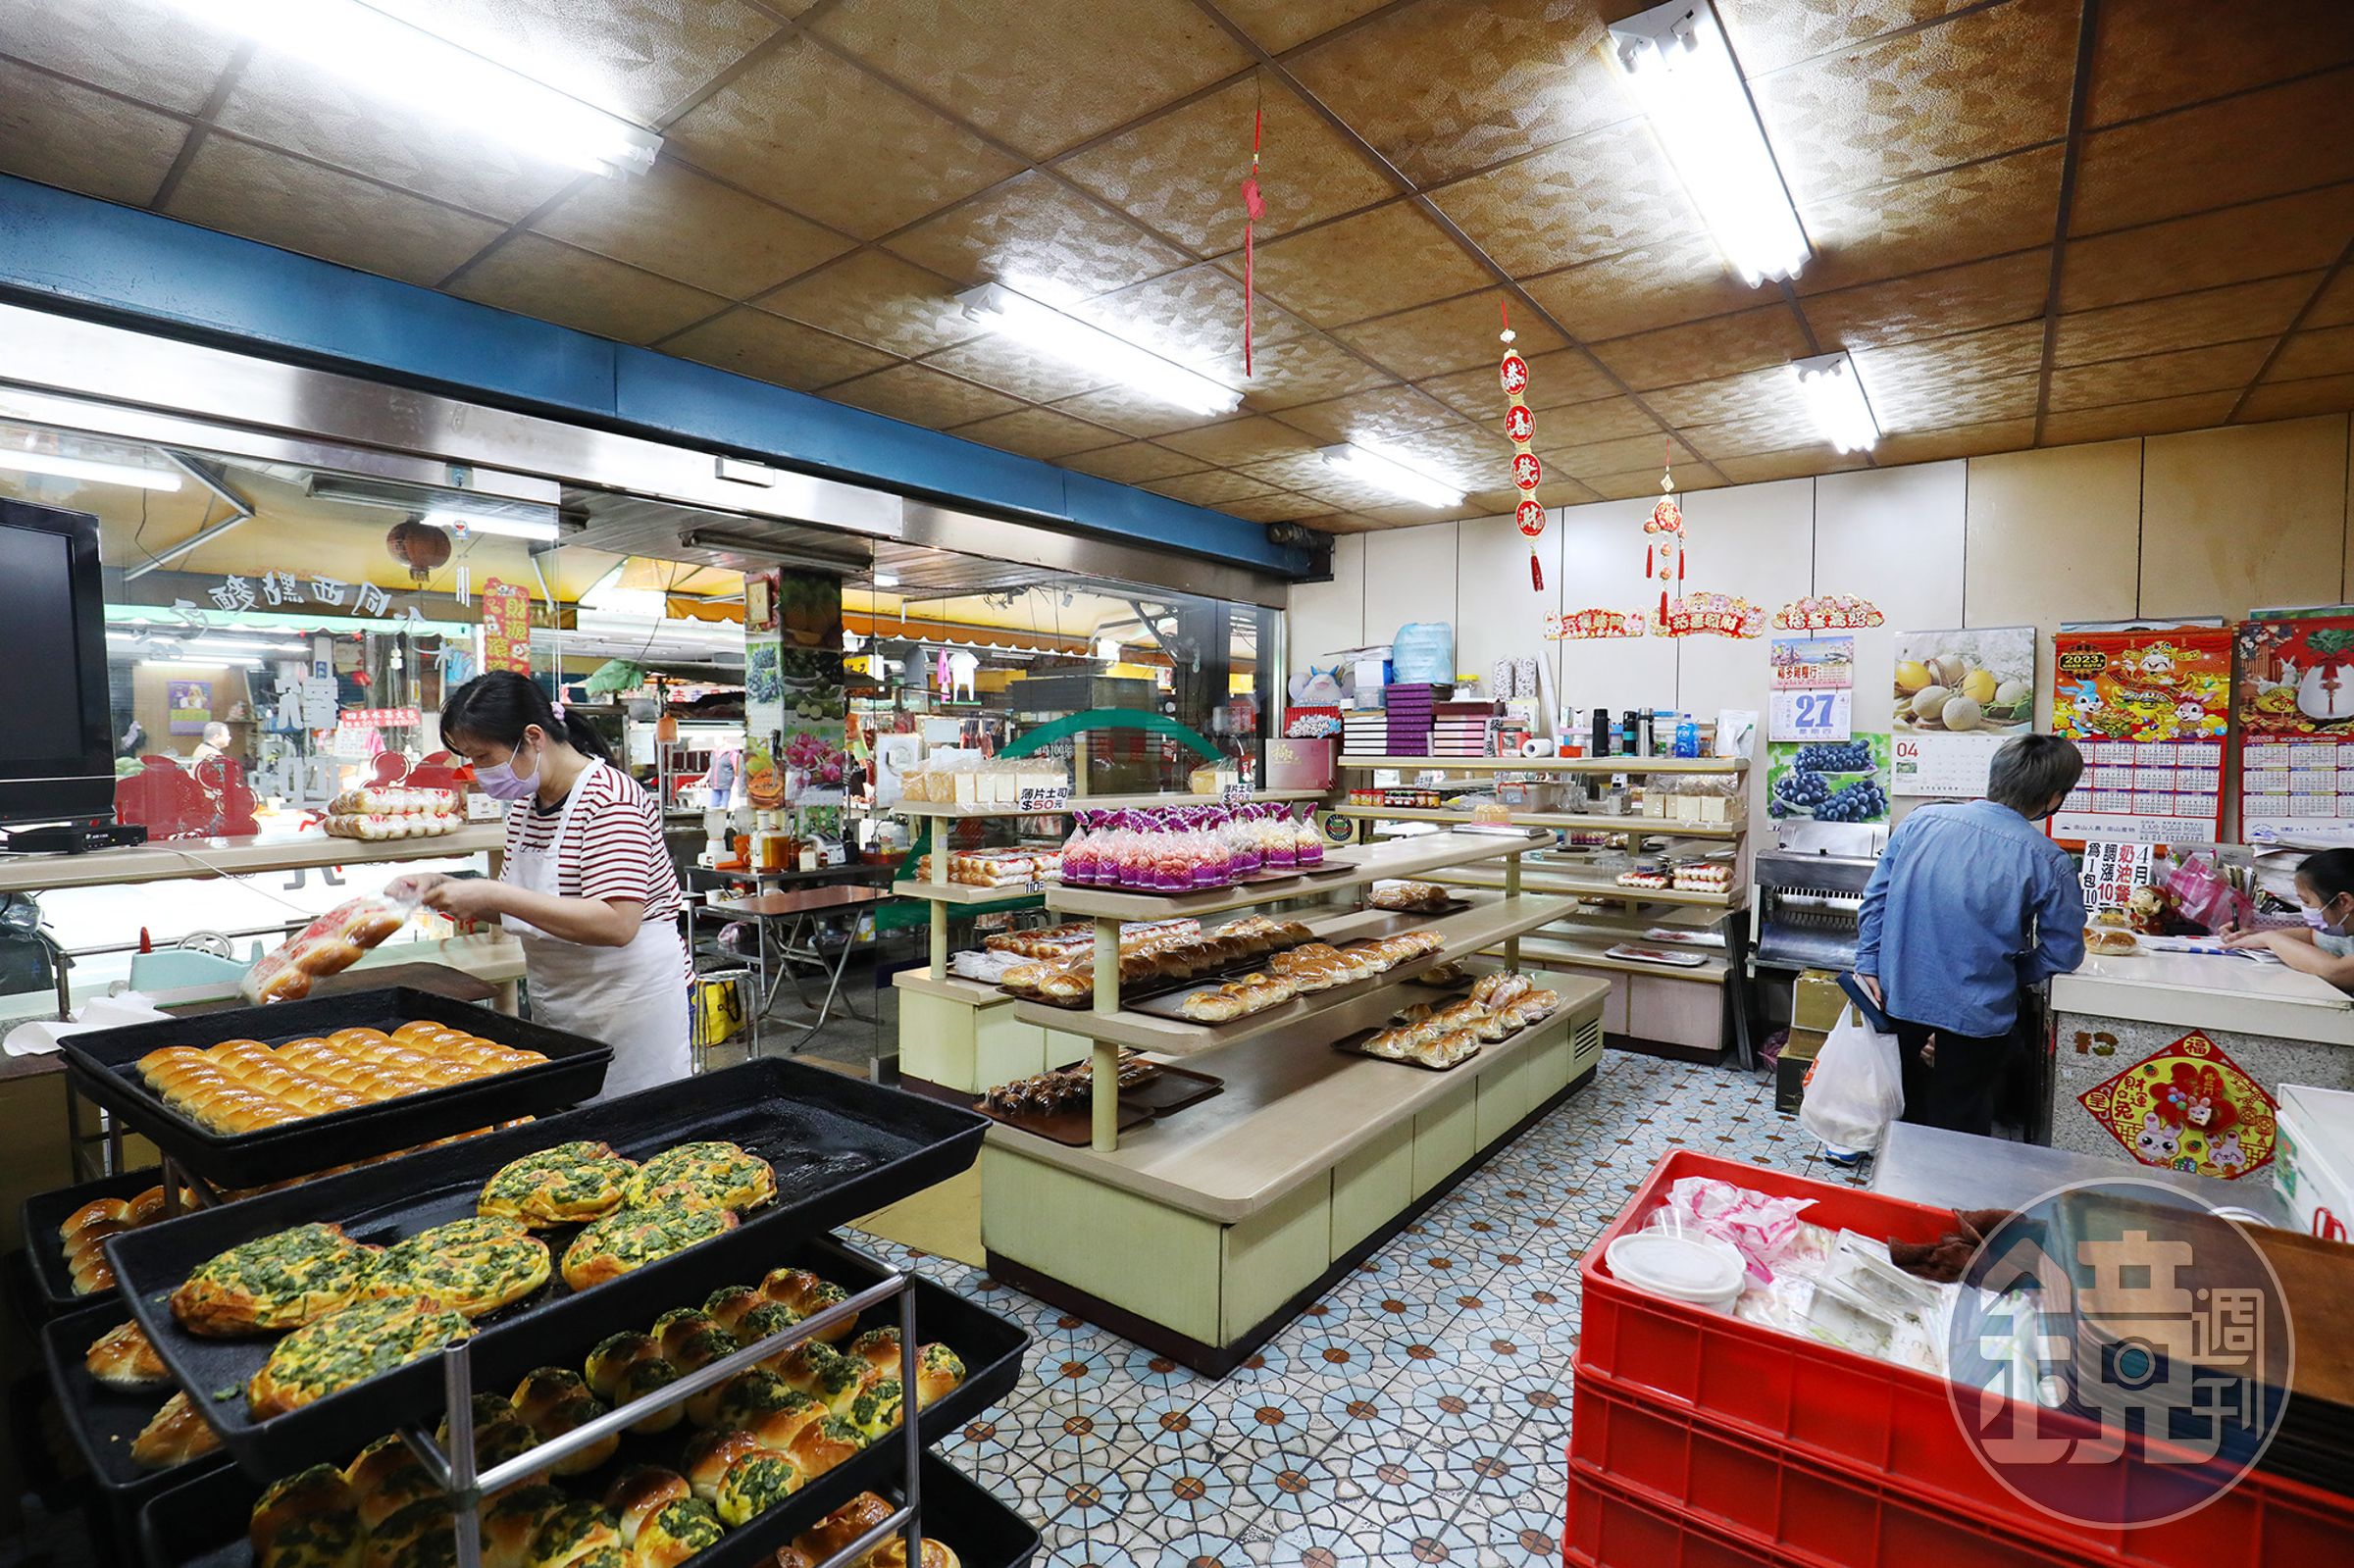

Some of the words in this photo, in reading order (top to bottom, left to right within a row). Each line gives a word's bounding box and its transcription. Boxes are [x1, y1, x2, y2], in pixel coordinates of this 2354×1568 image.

[1795, 694, 1836, 728] 27
[1896, 742, 1919, 758] 04
[1020, 787, 1068, 800] 薄片土司
[2115, 844, 2135, 908] 奶油餐
[2133, 845, 2150, 885] 4月
[2185, 1037, 2207, 1055] 福
